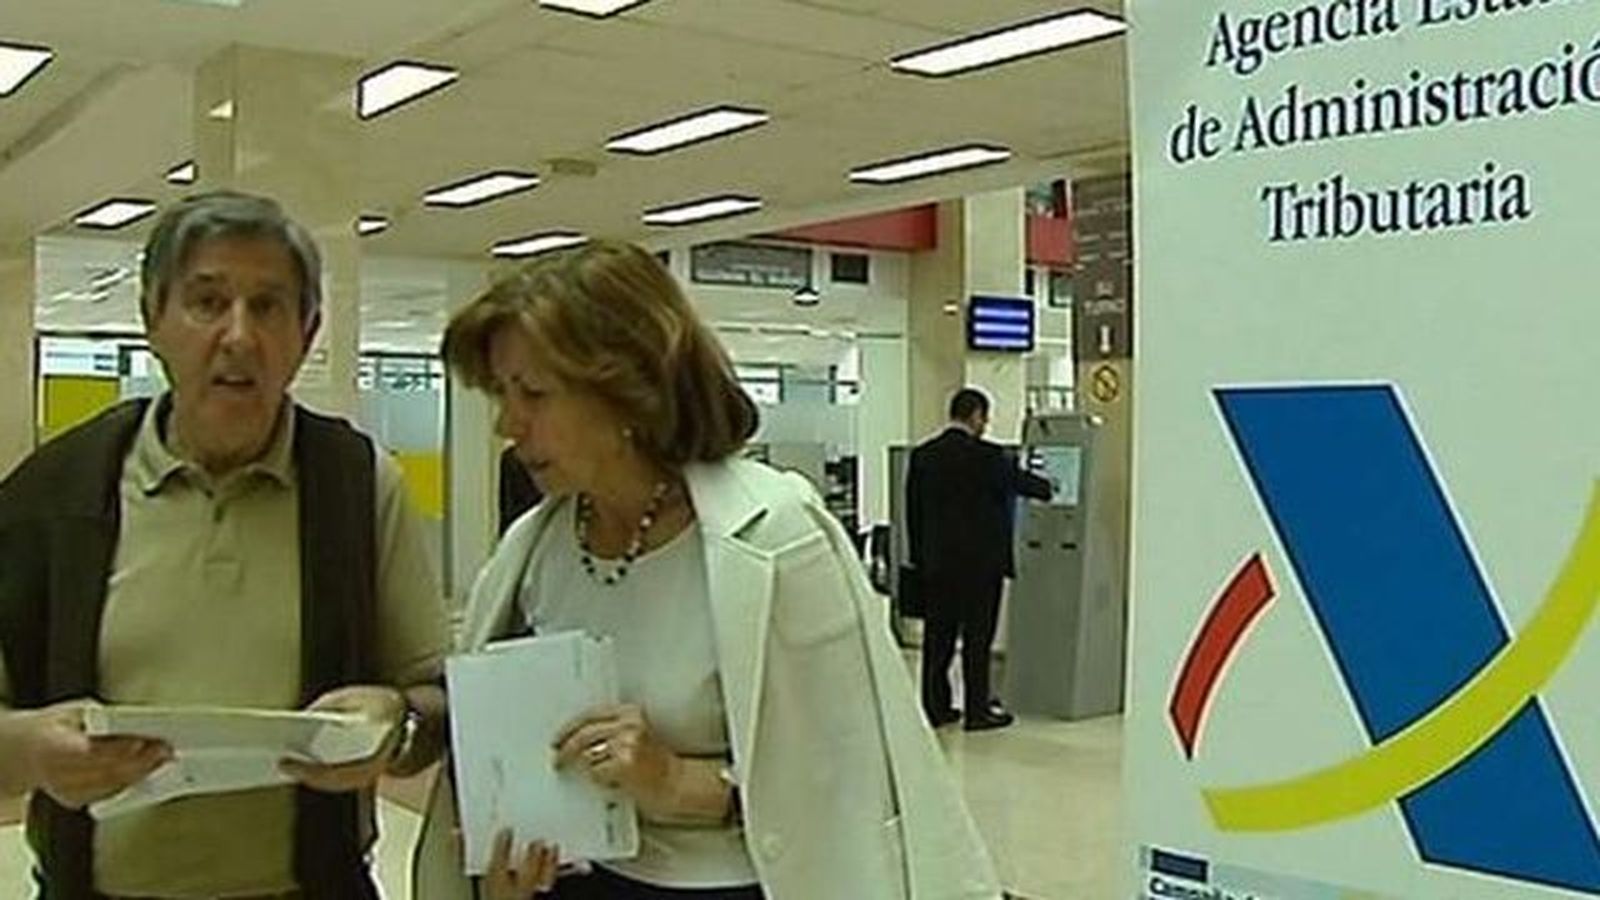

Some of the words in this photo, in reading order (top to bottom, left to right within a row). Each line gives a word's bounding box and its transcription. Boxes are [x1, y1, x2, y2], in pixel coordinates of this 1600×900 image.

[1206, 0, 1398, 74] Agencia
[1170, 105, 1222, 163] de
[1262, 162, 1531, 241] Tributaria
